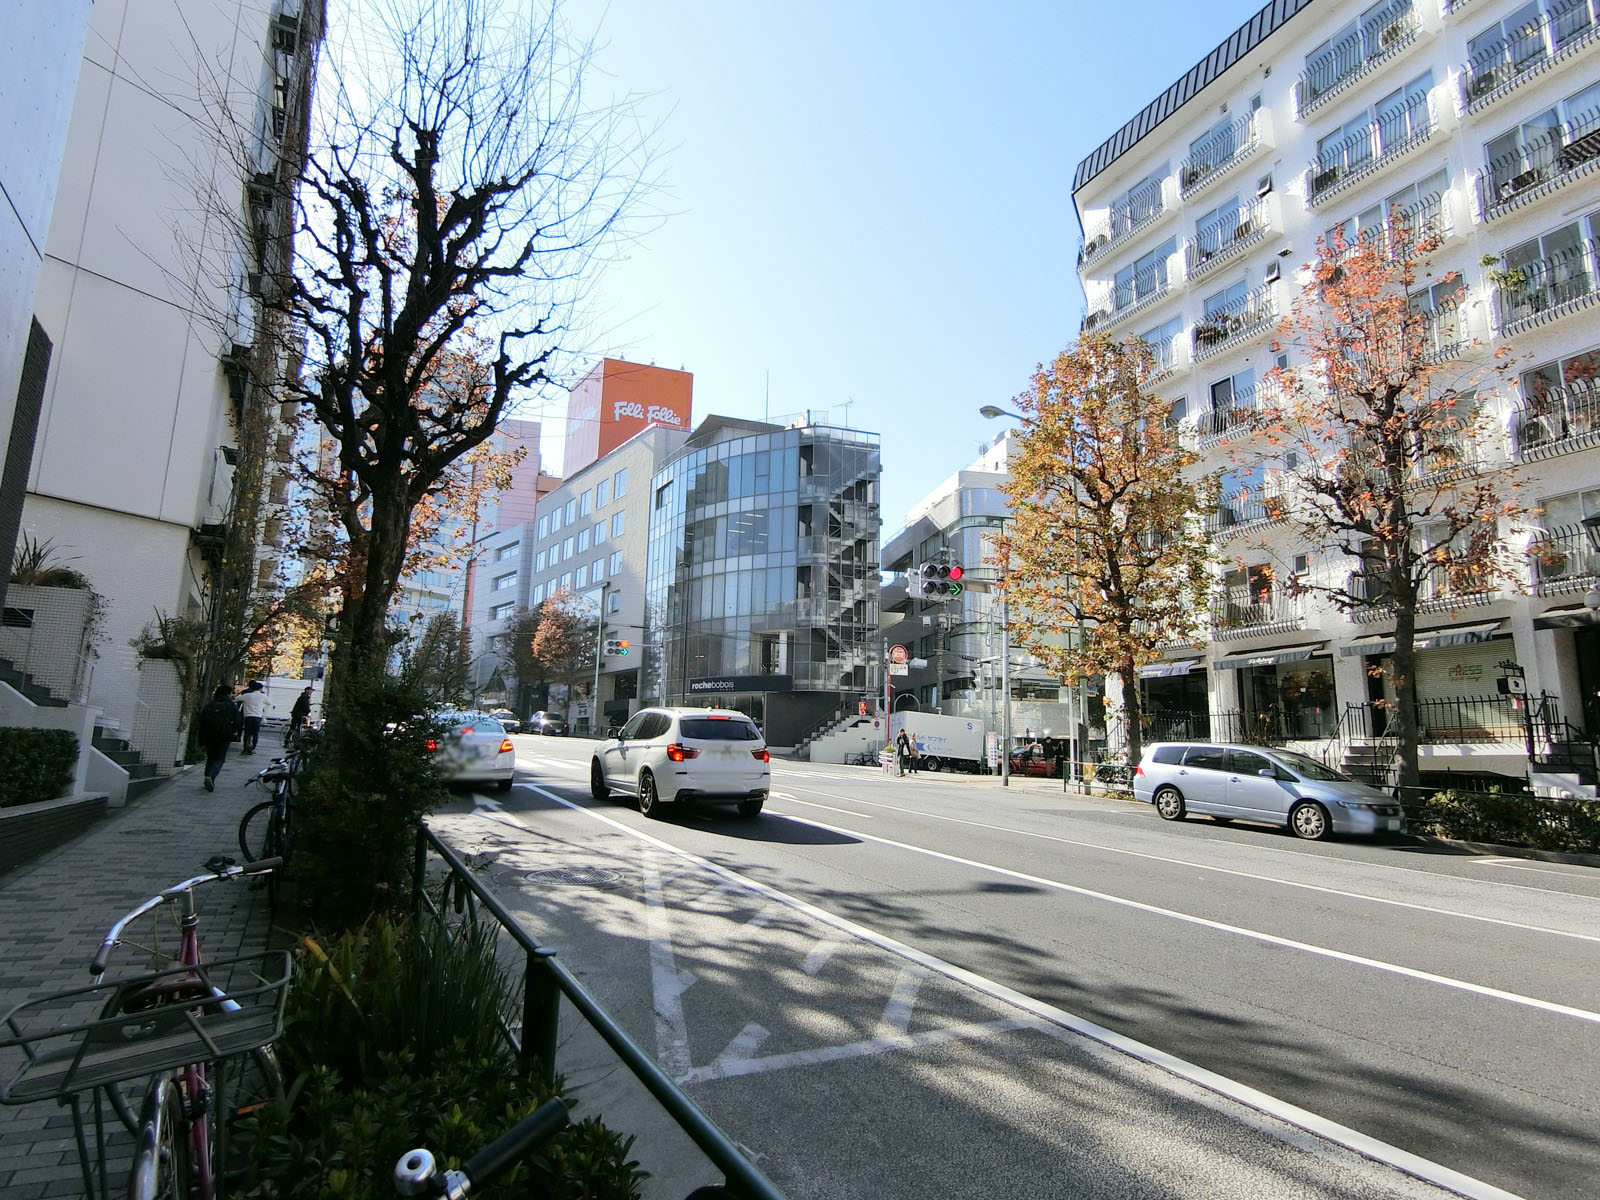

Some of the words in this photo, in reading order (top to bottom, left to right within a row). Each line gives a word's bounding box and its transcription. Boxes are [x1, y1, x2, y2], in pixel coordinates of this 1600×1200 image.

[614, 401, 644, 421] Folli
[647, 405, 681, 425] Follie
[967, 722, 973, 730] S
